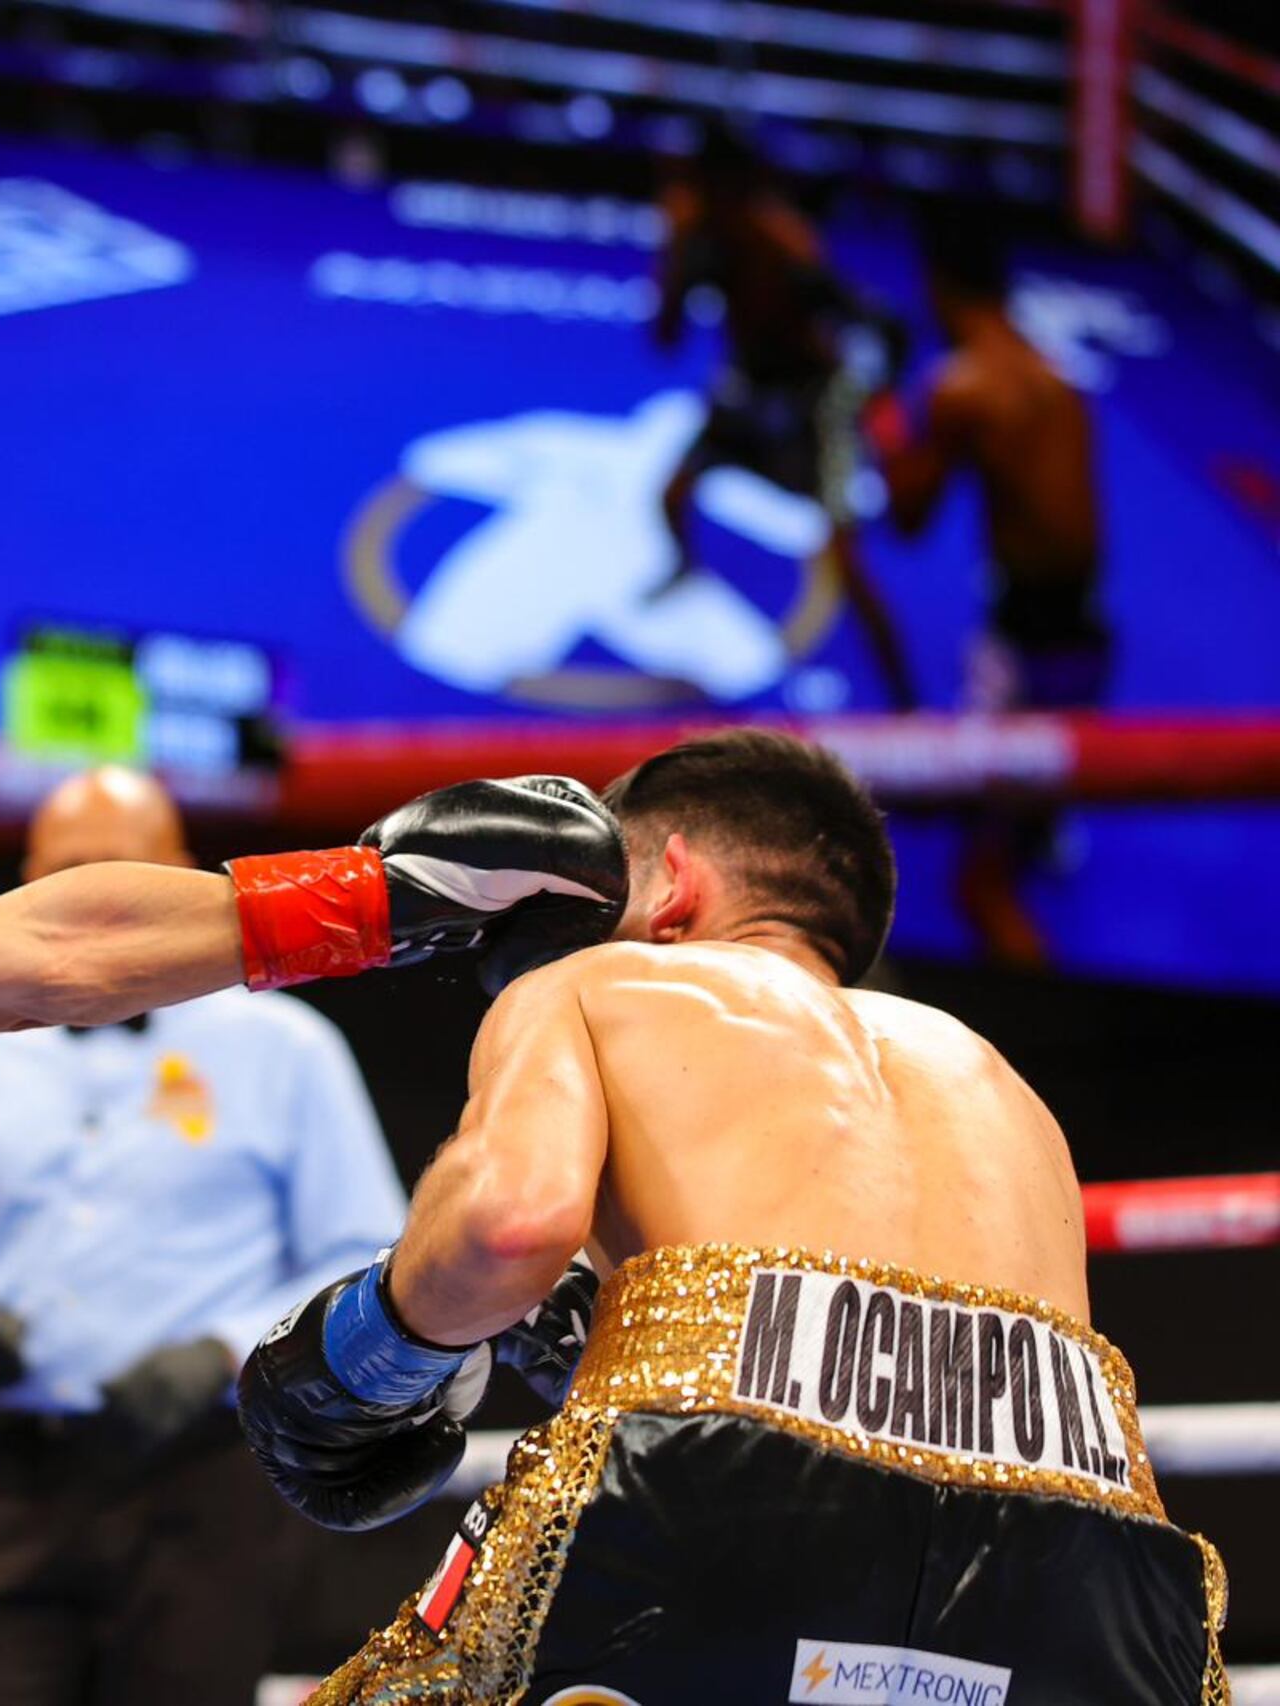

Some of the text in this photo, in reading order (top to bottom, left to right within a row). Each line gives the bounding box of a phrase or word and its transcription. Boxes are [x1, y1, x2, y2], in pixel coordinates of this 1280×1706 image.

[737, 1273, 802, 1409] M.
[818, 1279, 1046, 1463] OCAMPO
[834, 1659, 1003, 1706] MEXTRONIC
